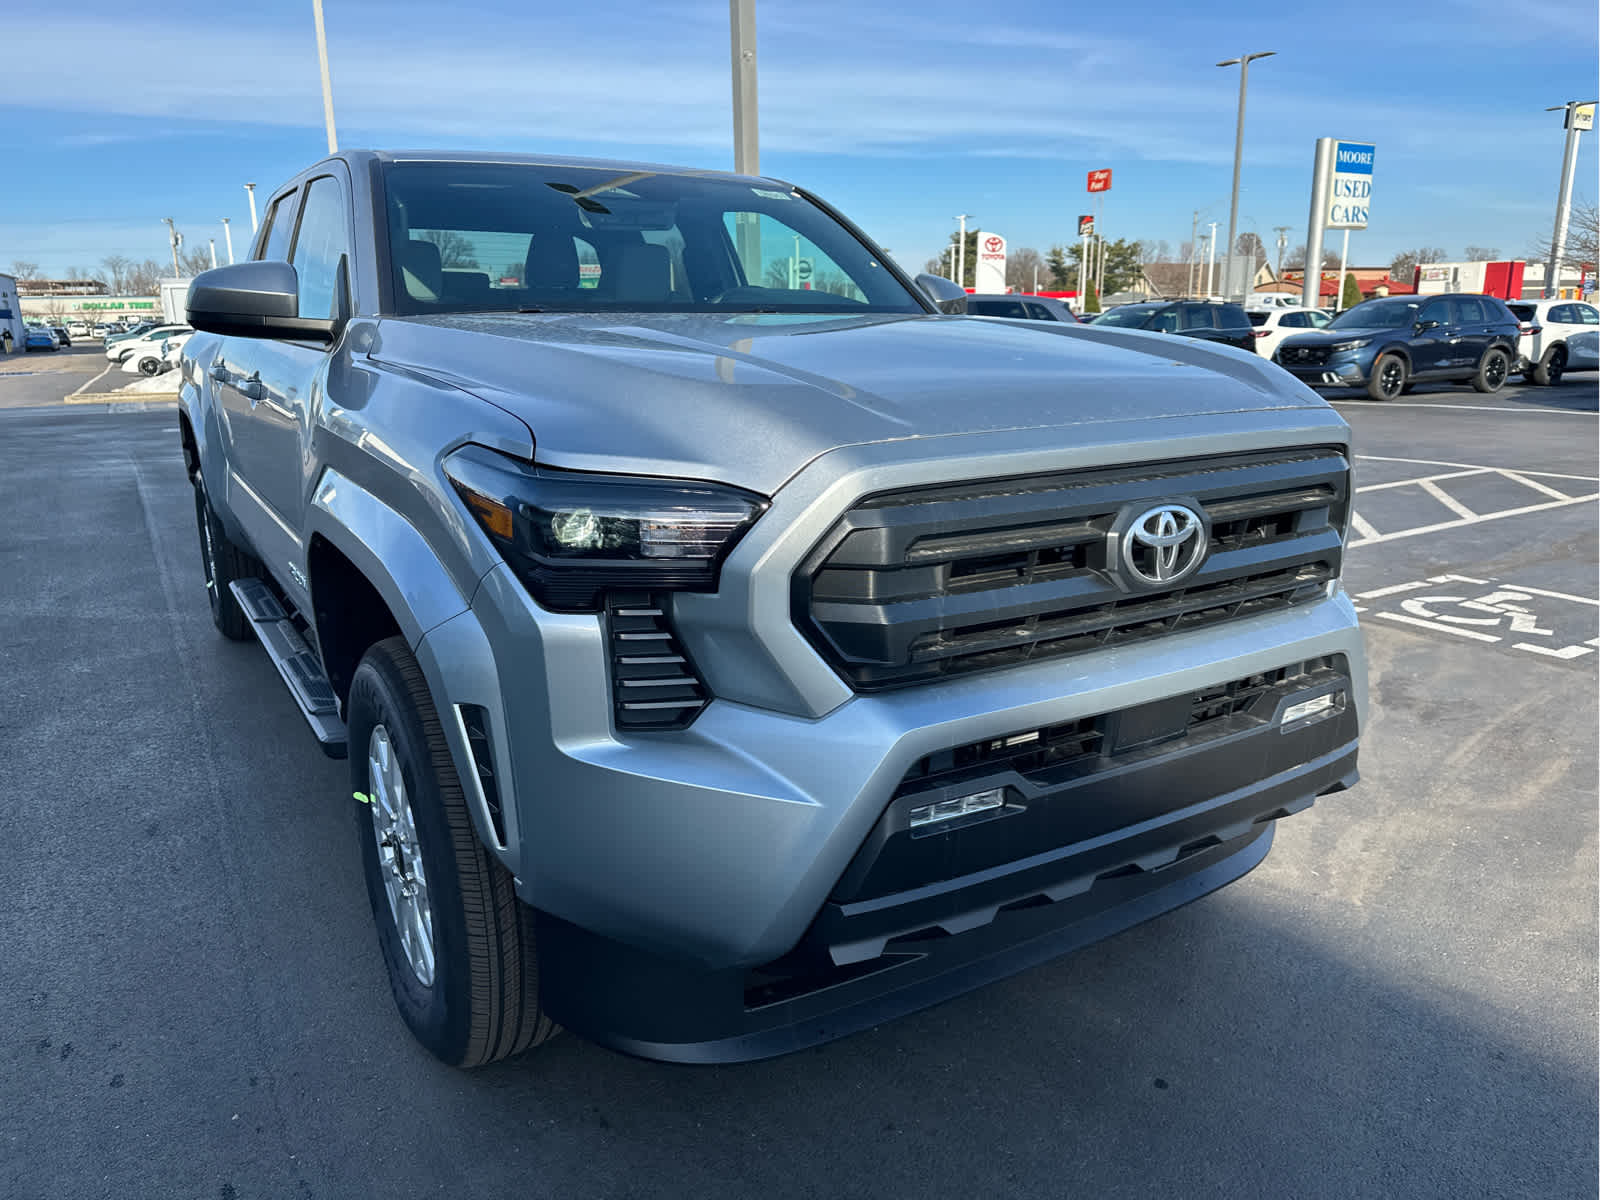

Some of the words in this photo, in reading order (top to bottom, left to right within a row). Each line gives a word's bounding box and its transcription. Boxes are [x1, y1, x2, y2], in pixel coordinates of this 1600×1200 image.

[1339, 150, 1373, 164] MOORE
[1334, 179, 1371, 198] USED
[1331, 204, 1369, 223] CARS
[82, 302, 125, 310] DOLLAR
